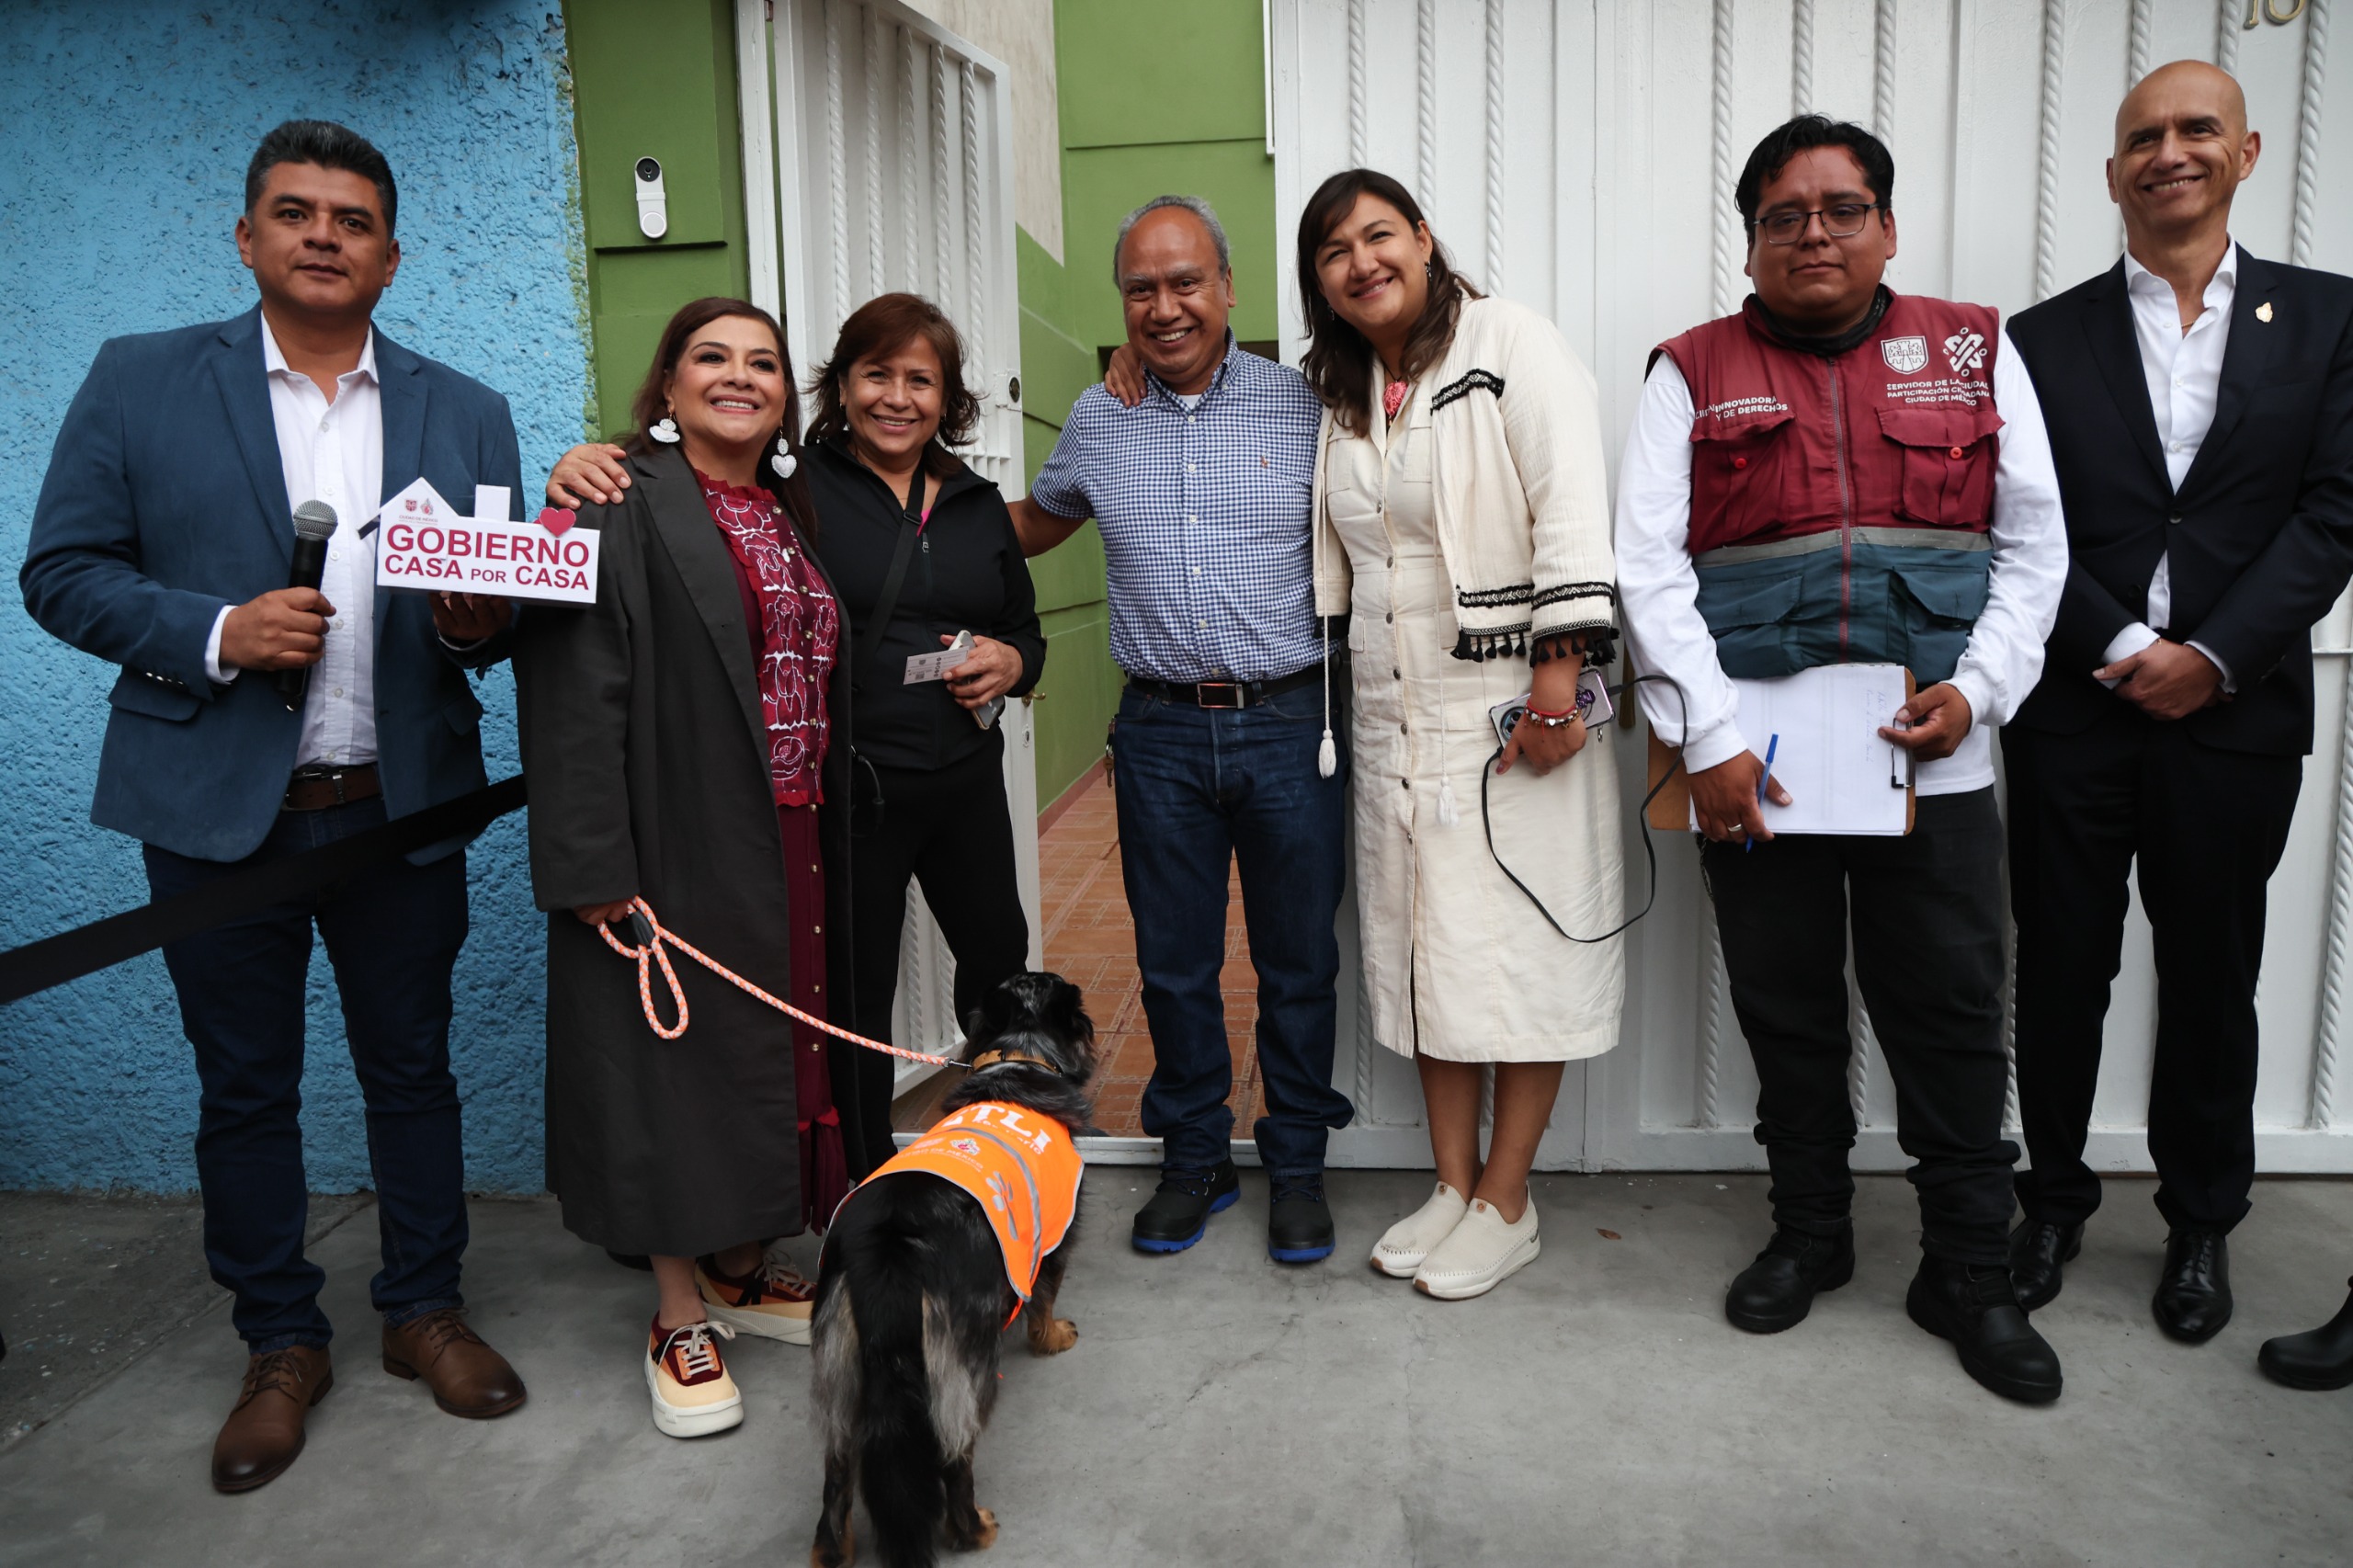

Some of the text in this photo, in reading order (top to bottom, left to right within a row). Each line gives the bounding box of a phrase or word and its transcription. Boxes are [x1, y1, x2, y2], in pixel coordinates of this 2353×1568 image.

[1886, 381, 1932, 391] SERVIDOR
[1949, 378, 1961, 386] LA
[1887, 387, 1949, 398] PARTICIPACIÓN
[1715, 396, 1777, 413] INNOVADORA
[1938, 394, 1949, 403] DE
[1950, 393, 1977, 406] MÉXCO
[1715, 403, 1788, 422] Y DE DERECHOS
[387, 524, 590, 568] GOBIERNO
[384, 554, 590, 591] CASA POR CASA
